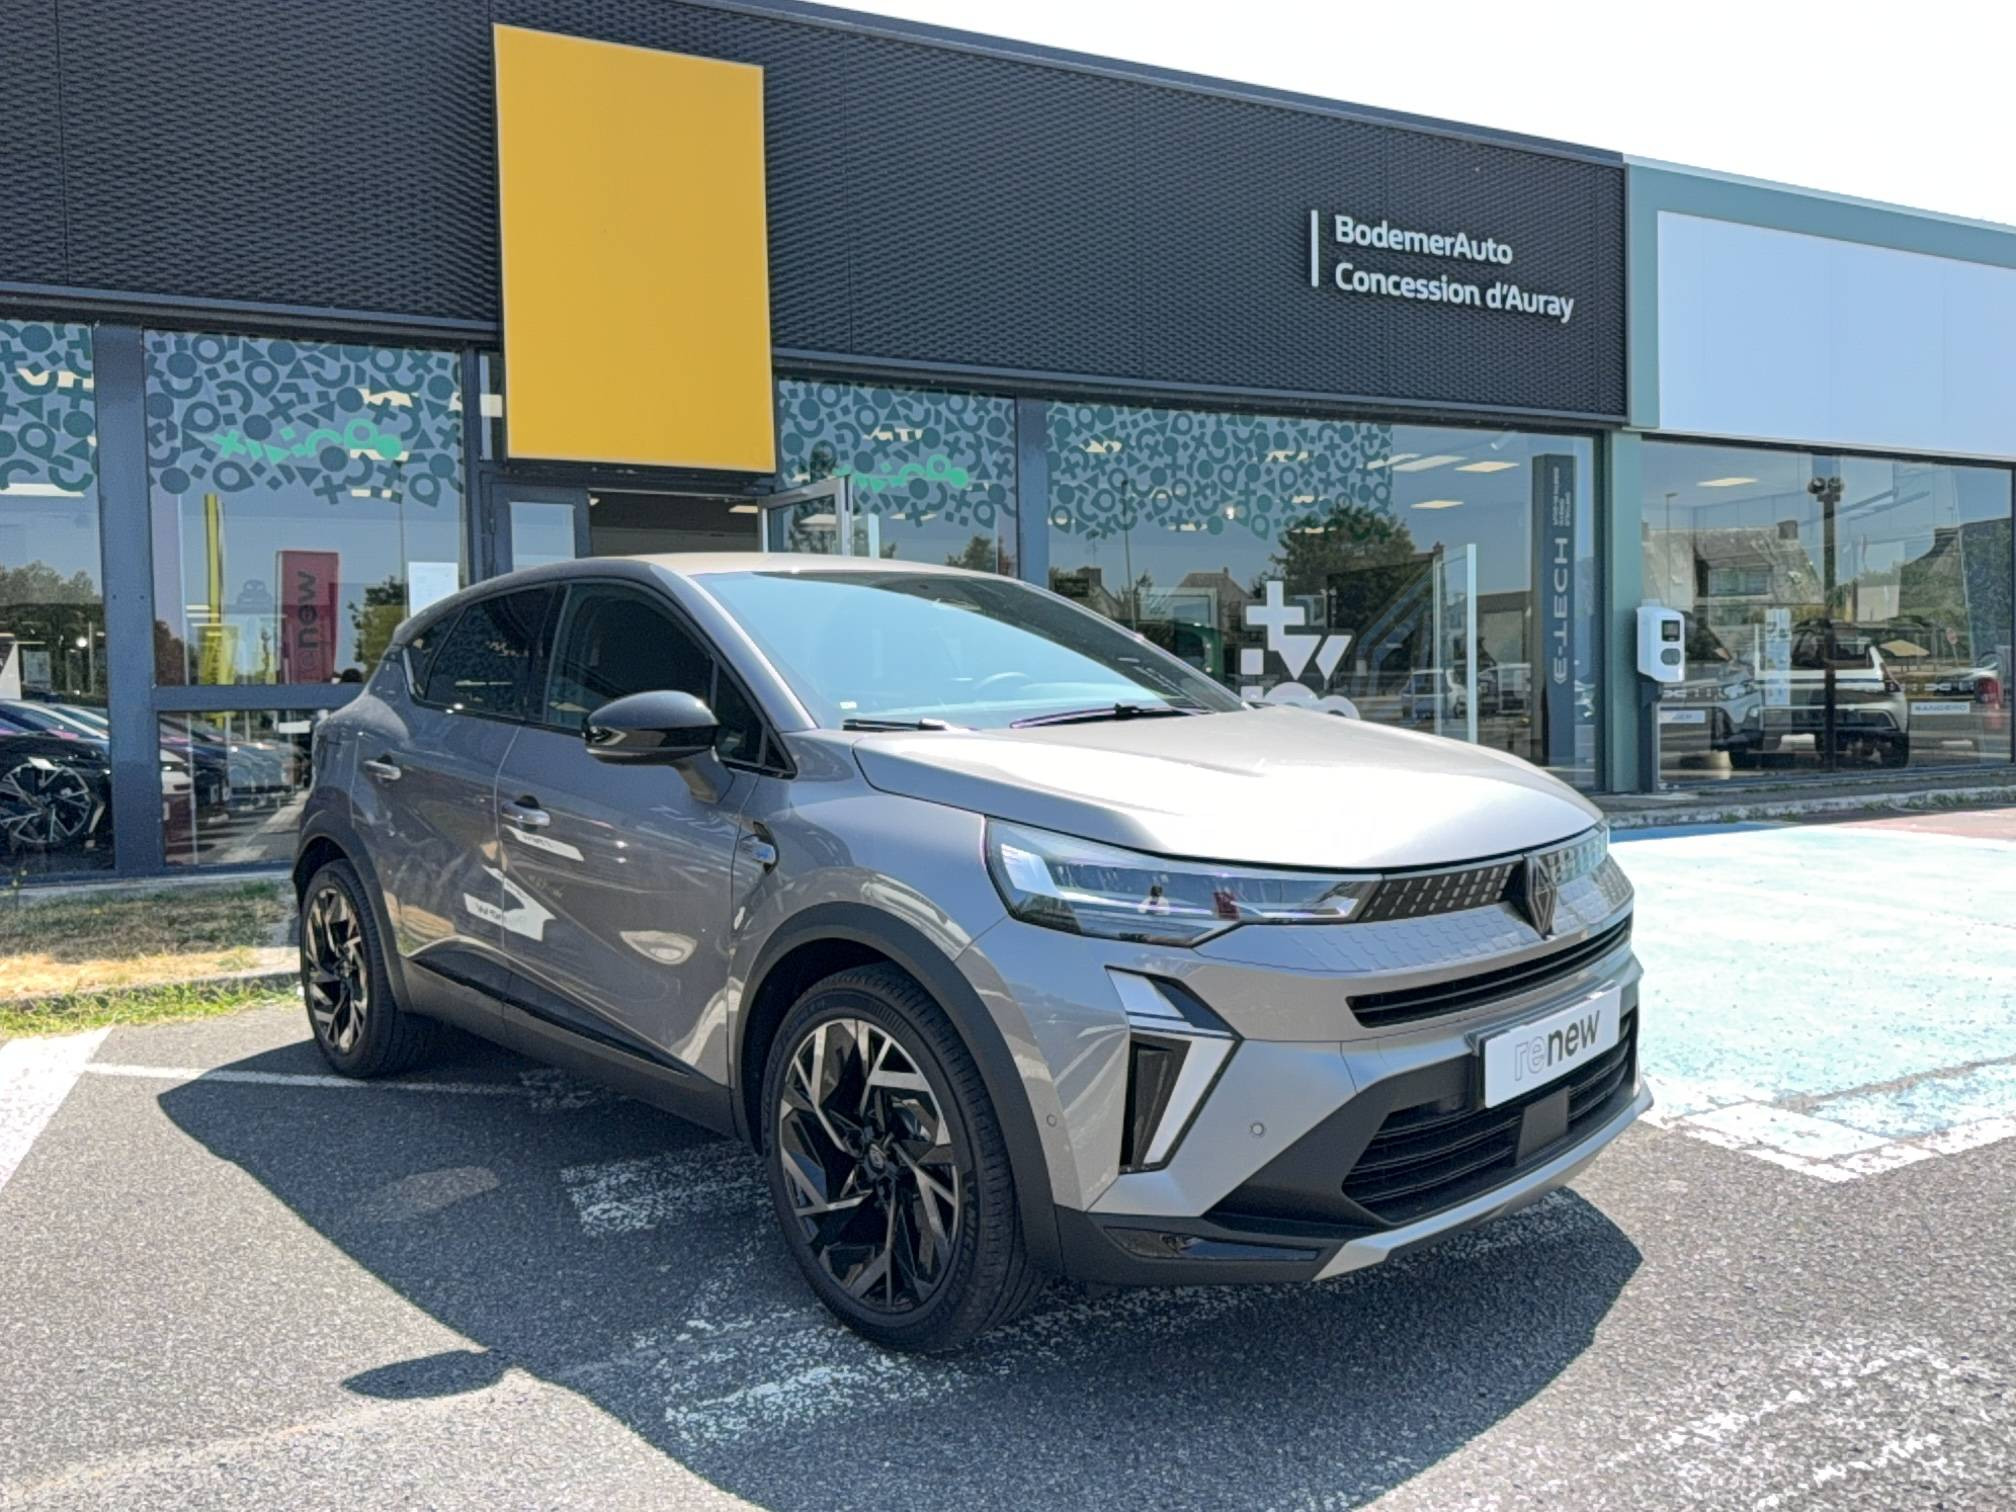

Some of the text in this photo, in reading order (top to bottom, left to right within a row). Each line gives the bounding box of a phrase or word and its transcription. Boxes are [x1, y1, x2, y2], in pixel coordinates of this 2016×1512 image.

[1334, 214, 1513, 265] BodemerAuto
[1335, 263, 1575, 324] Concession d'Auray
[1514, 1009, 1601, 1081] renew
